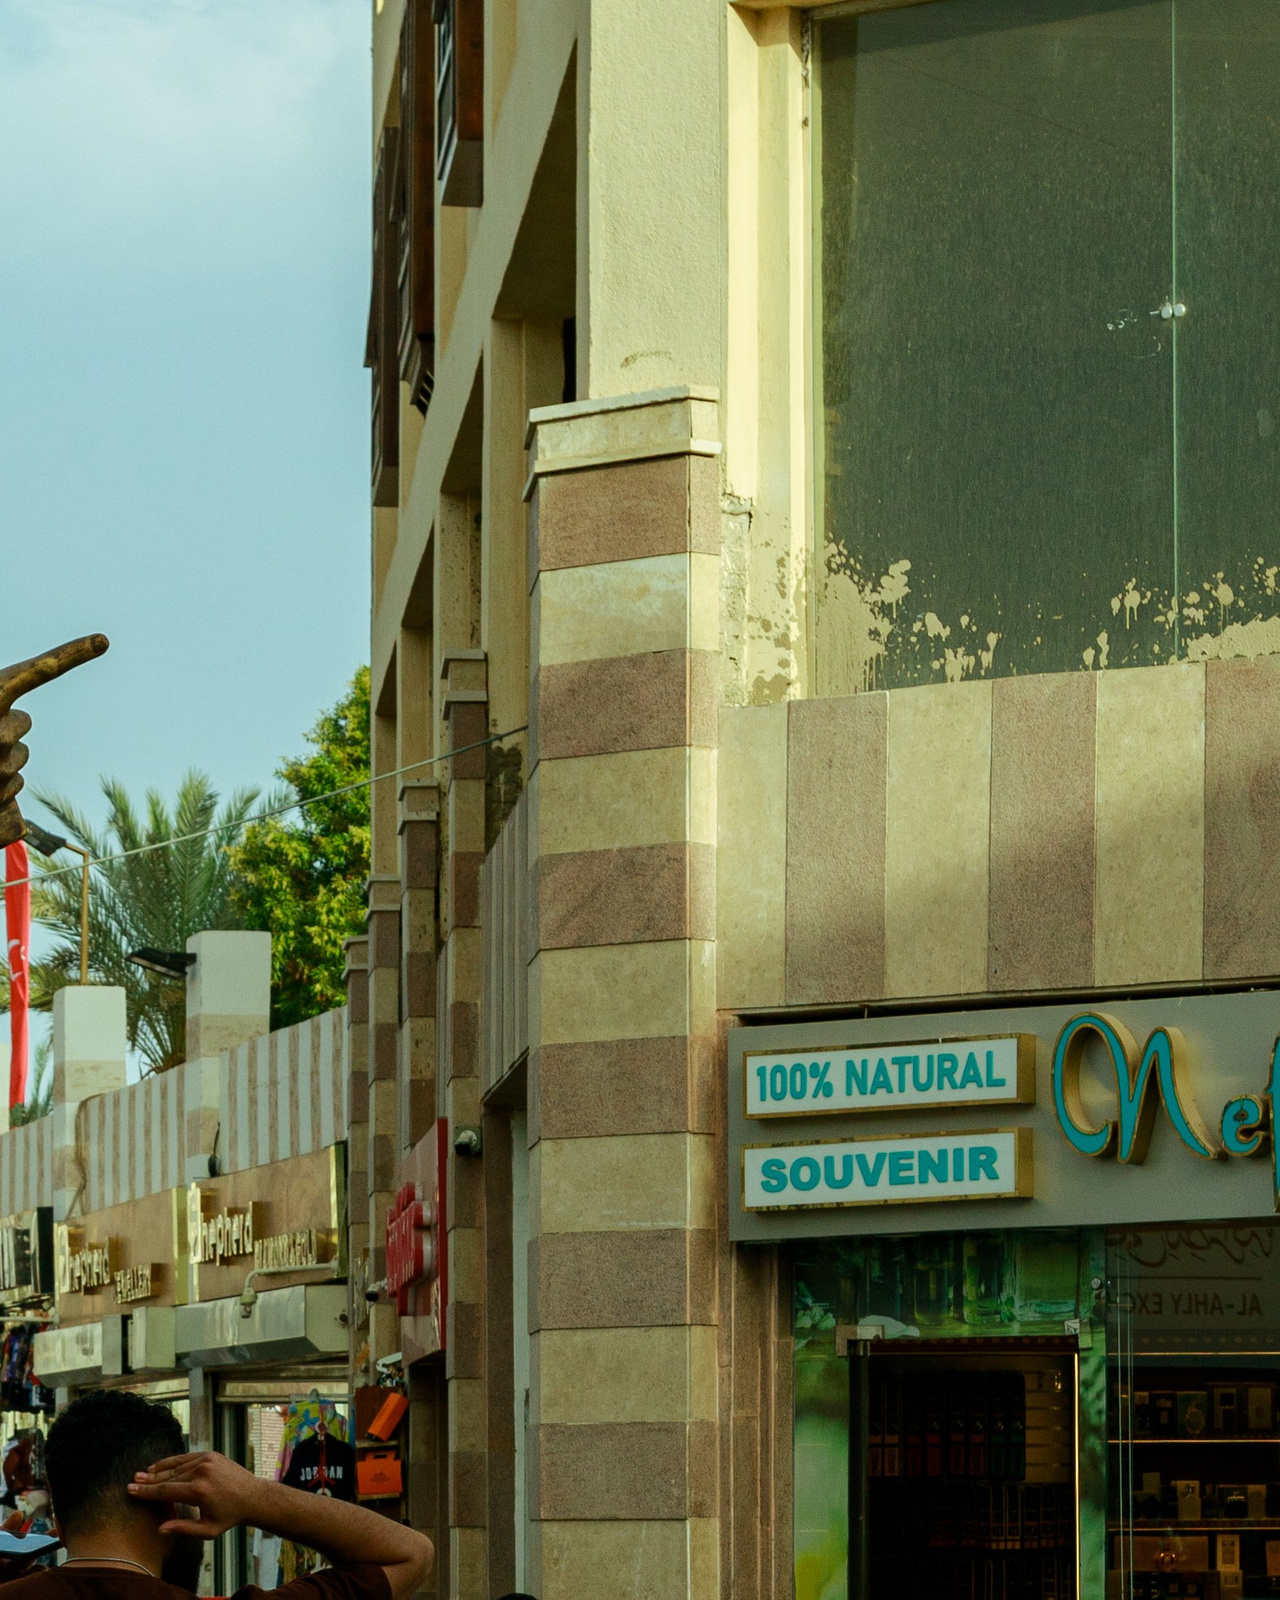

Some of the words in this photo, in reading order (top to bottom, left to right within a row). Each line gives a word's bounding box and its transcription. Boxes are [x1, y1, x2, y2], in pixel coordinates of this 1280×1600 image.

[756, 1061, 833, 1102] 100%
[844, 1050, 1007, 1097] NATURAL
[761, 1146, 1000, 1193] SOUVENIR
